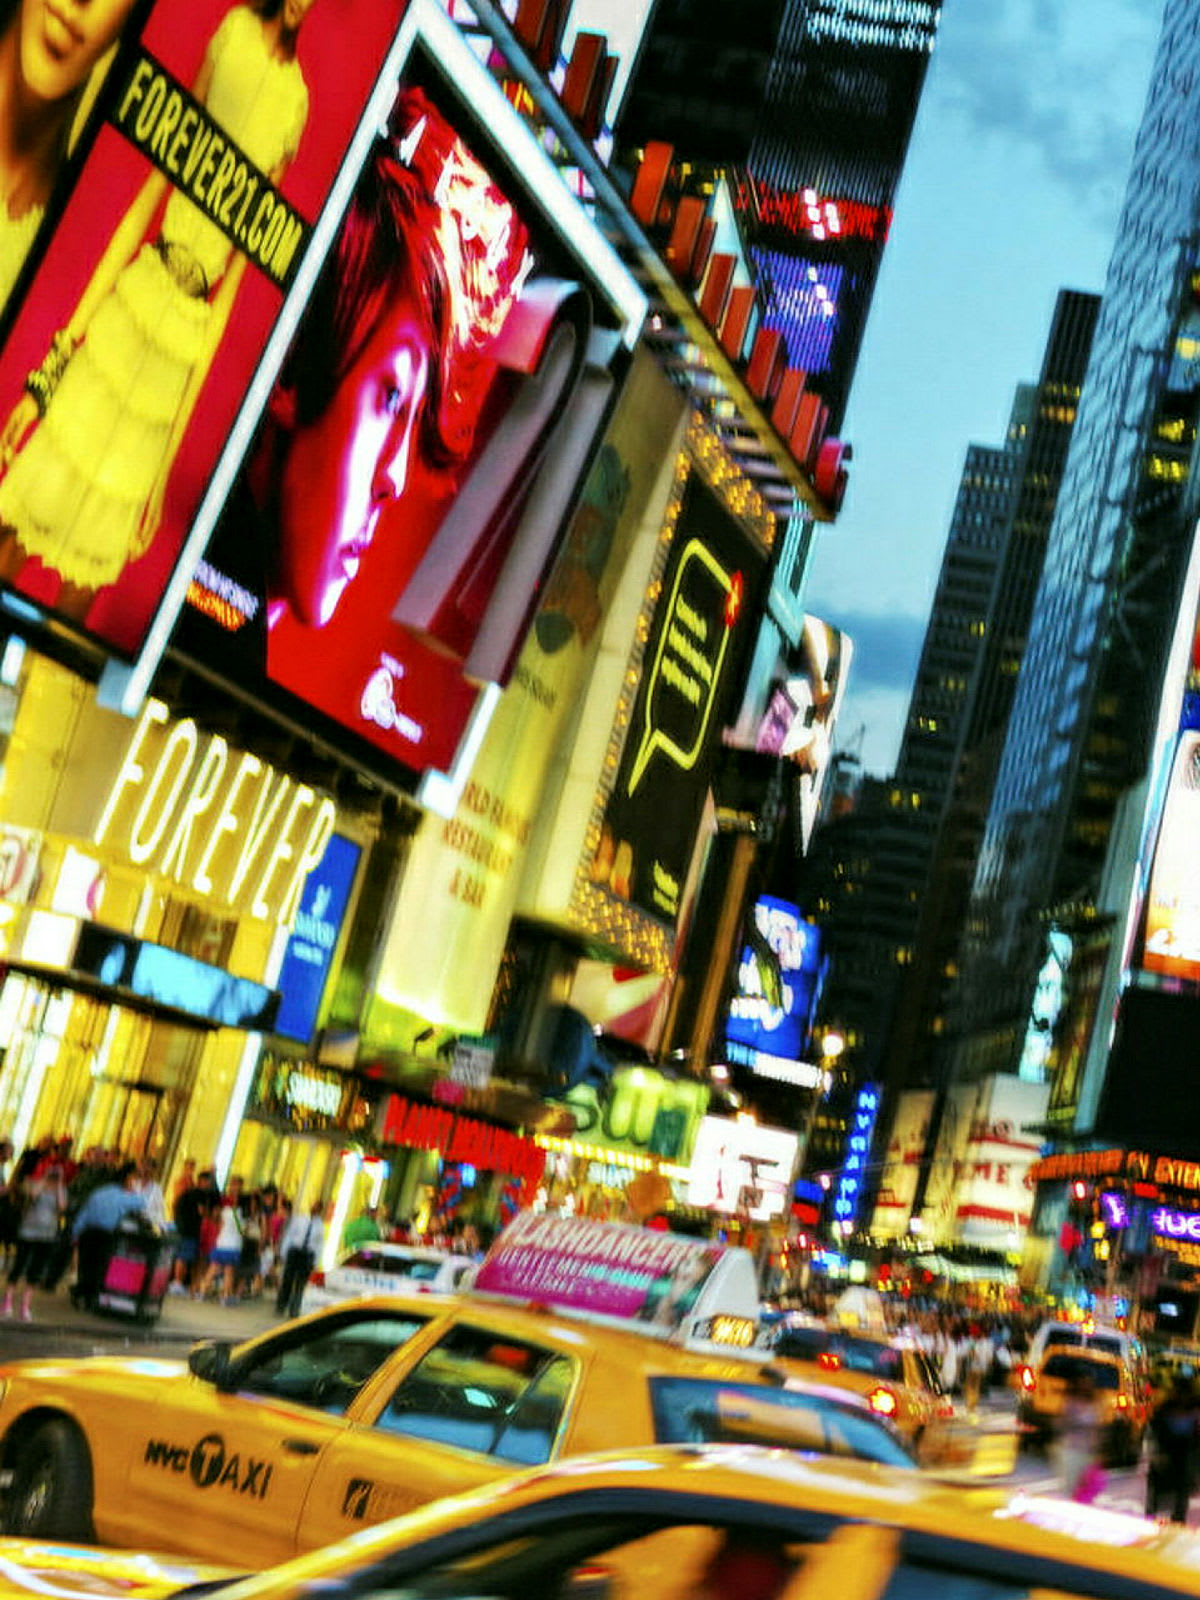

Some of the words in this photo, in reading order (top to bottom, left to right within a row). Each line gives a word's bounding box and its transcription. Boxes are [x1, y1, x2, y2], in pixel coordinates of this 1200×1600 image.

[118, 60, 304, 281] FOREVER21.COM
[94, 696, 337, 936] FOREVER
[144, 1439, 190, 1472] NYC
[190, 1433, 274, 1501] TAXI
